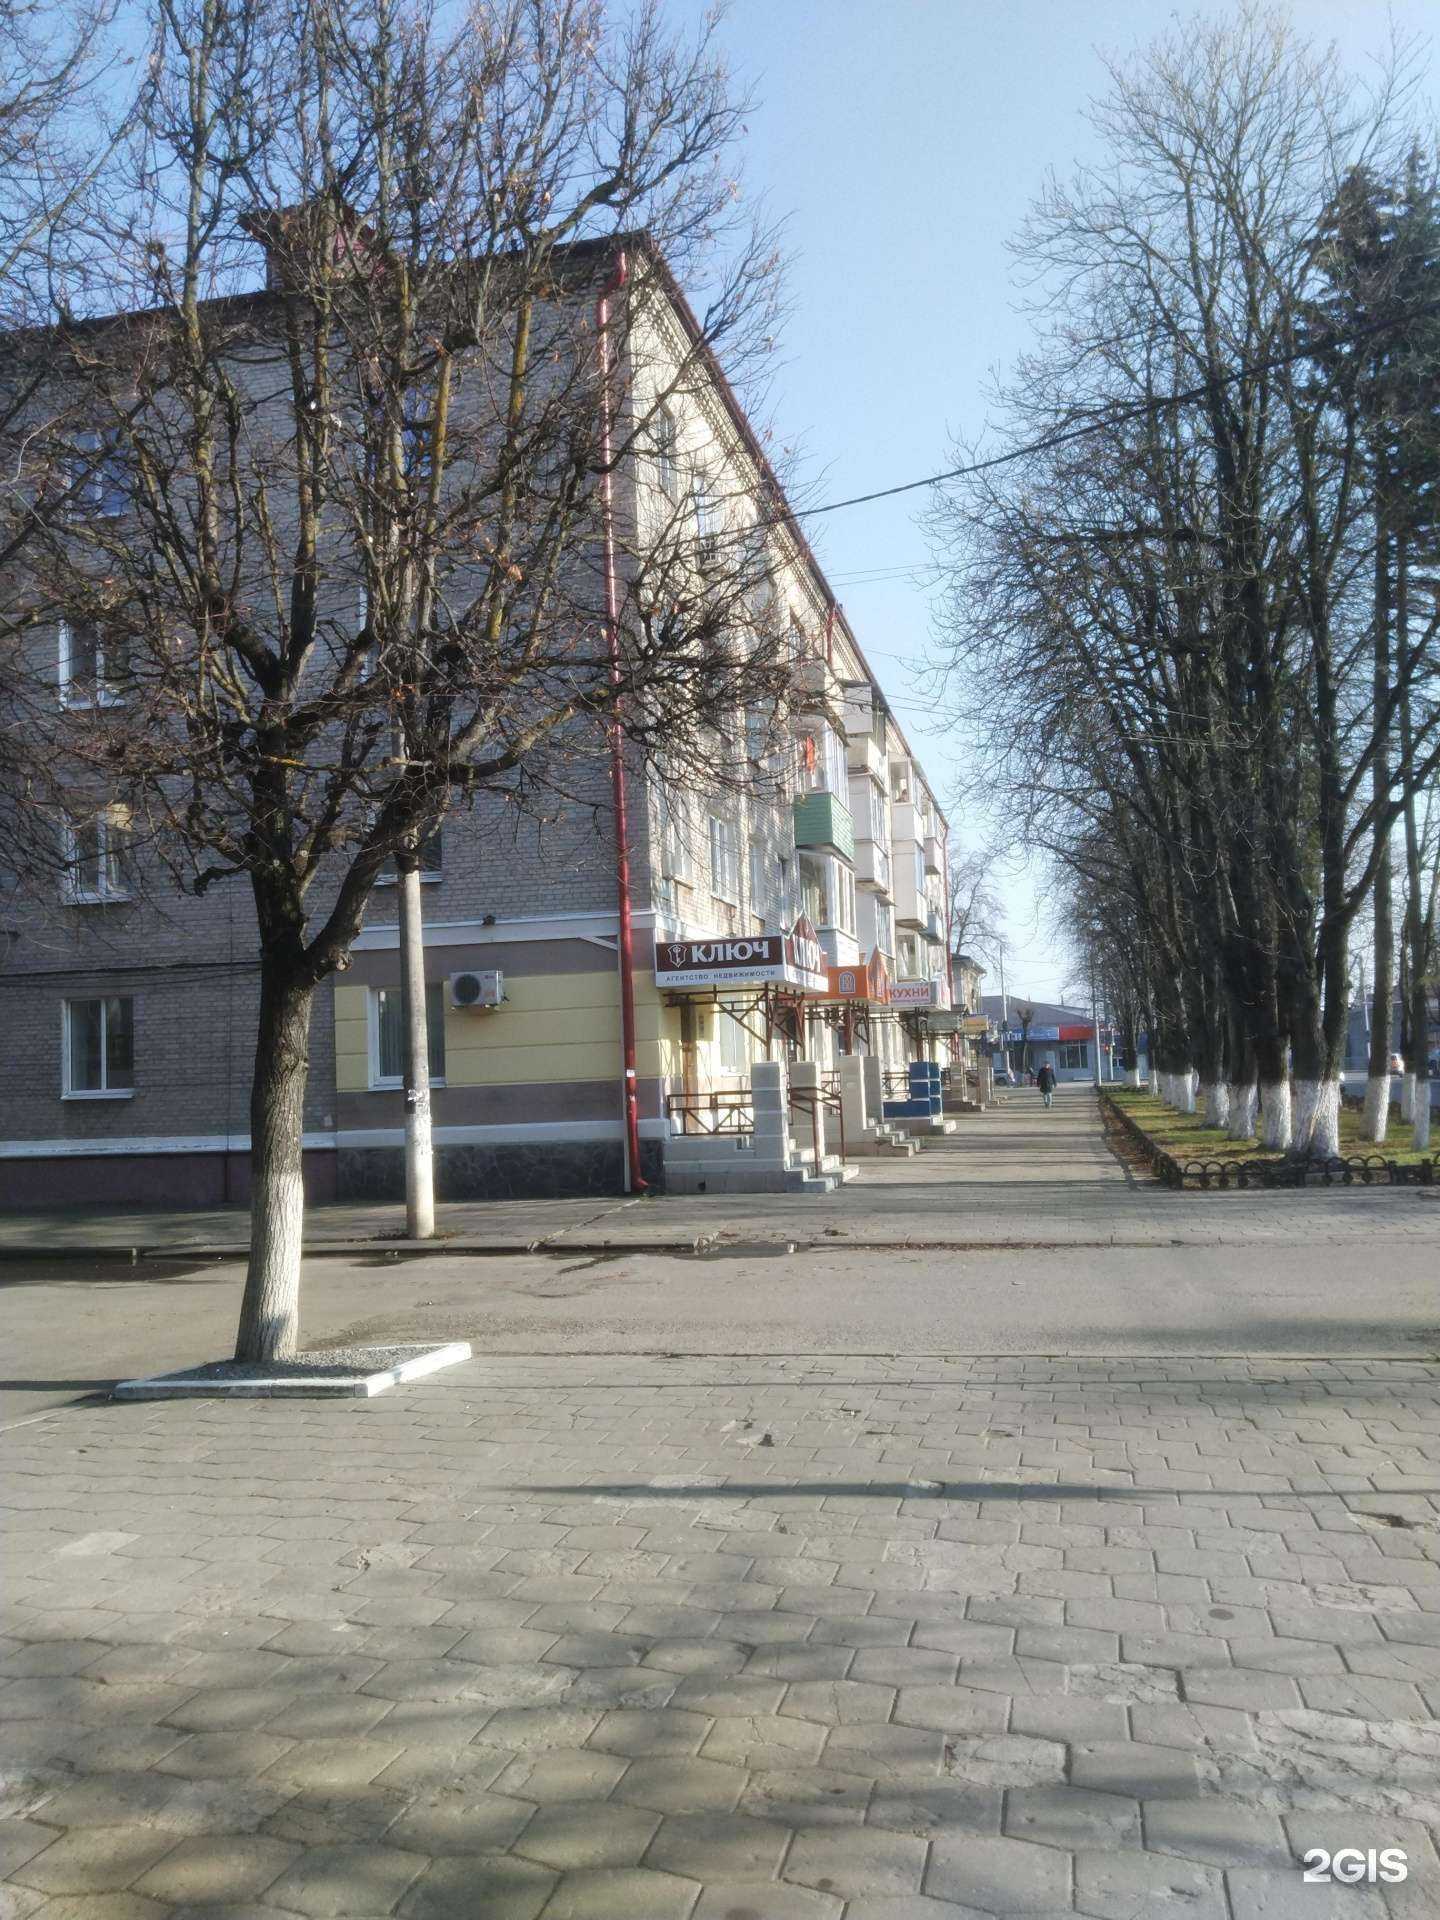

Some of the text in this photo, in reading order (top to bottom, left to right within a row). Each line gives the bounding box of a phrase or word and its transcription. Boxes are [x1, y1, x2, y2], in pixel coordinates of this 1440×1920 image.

[691, 940, 770, 963] КЛЮЧ
[666, 970, 775, 982] АГЕНТСТВО НЕДВИЖИМОСТИ
[889, 987, 929, 999] КУХНИ
